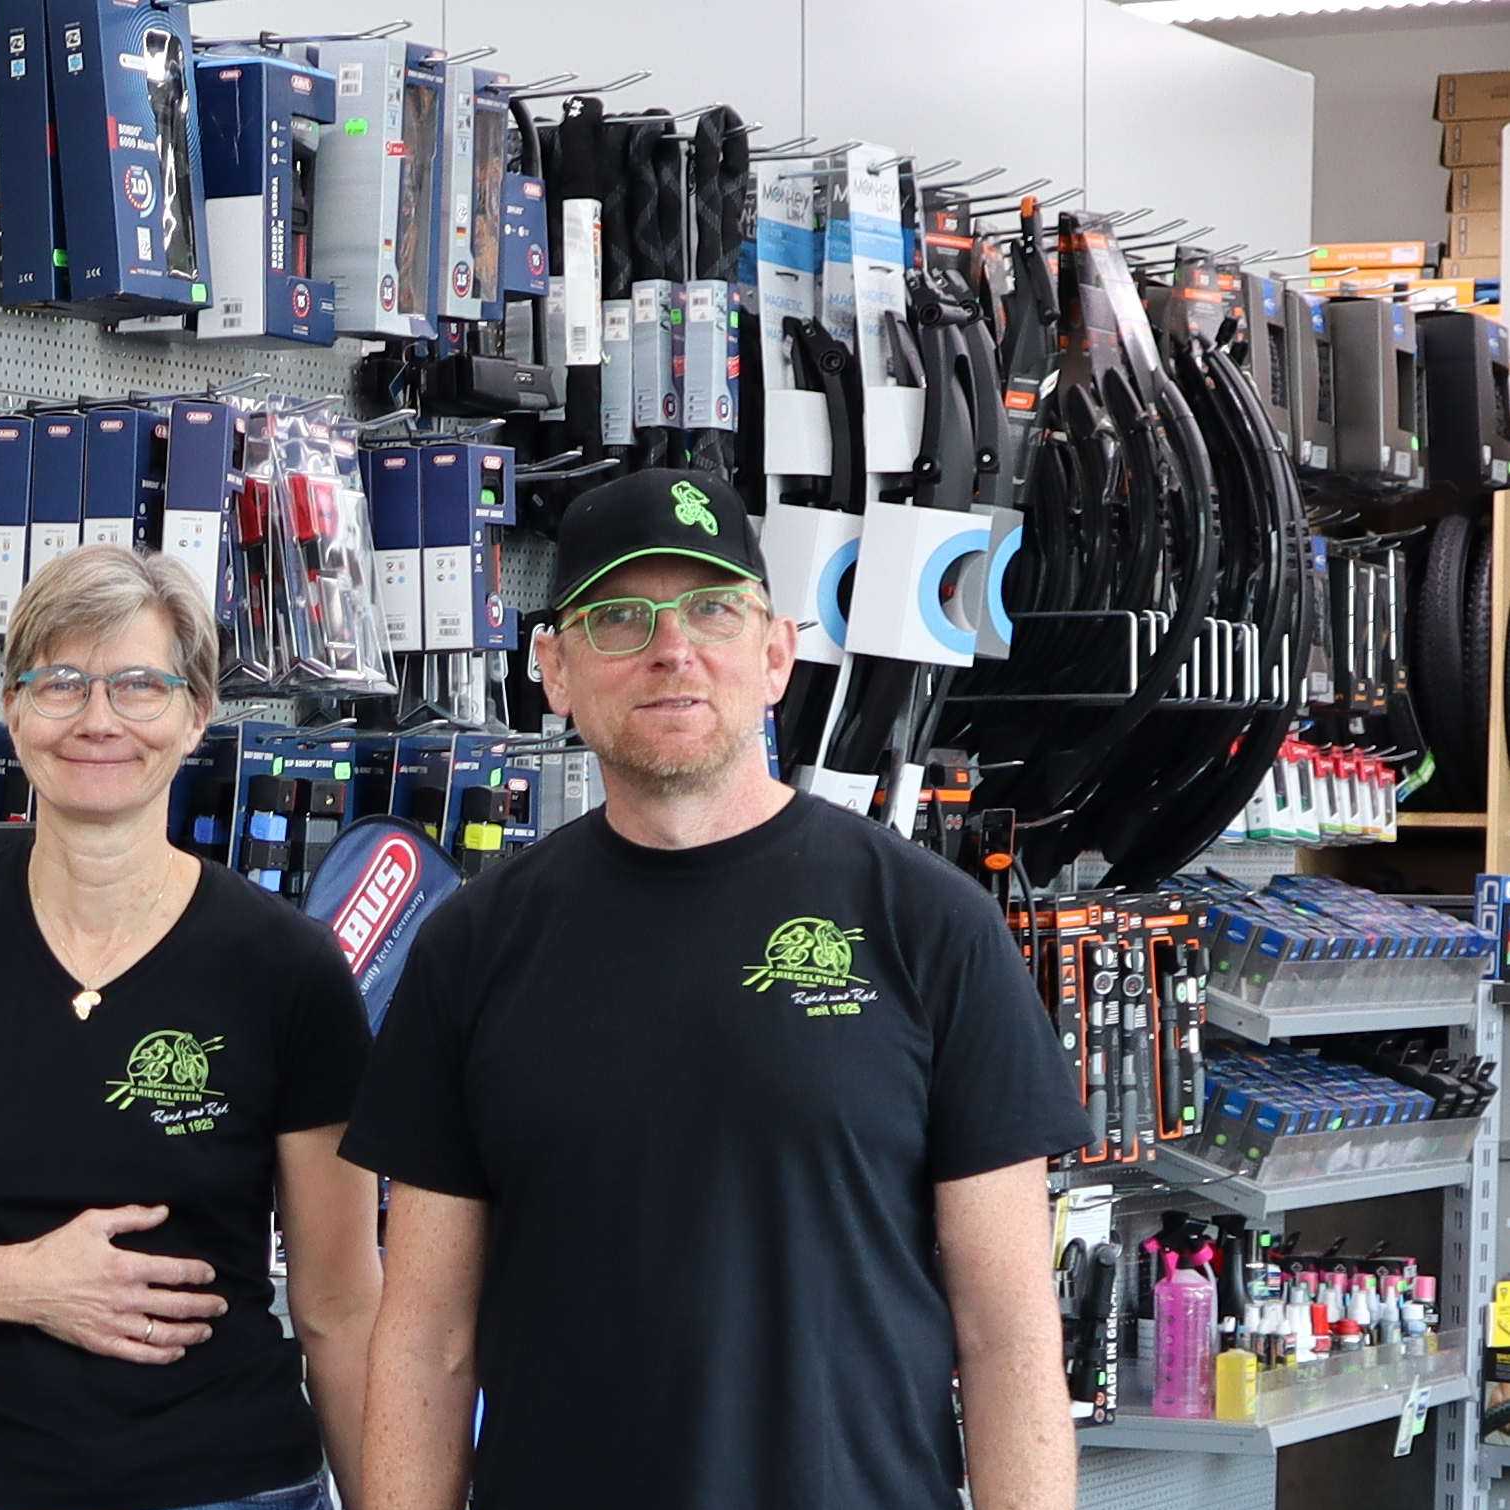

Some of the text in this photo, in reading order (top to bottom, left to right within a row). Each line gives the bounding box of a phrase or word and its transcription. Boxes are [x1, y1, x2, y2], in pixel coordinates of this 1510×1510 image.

[339, 855, 405, 964] BUS
[375, 939, 395, 965] Tech
[392, 890, 426, 938] Germany
[768, 970, 847, 987] KRIEGELSTEIN
[806, 1001, 861, 1017] seit 1925
[129, 1087, 203, 1102] KRIEGELSTEIN
[165, 1117, 215, 1135] seit 1925
[1106, 1343, 1117, 1360] IN
[1106, 1362, 1117, 1410] MADE
